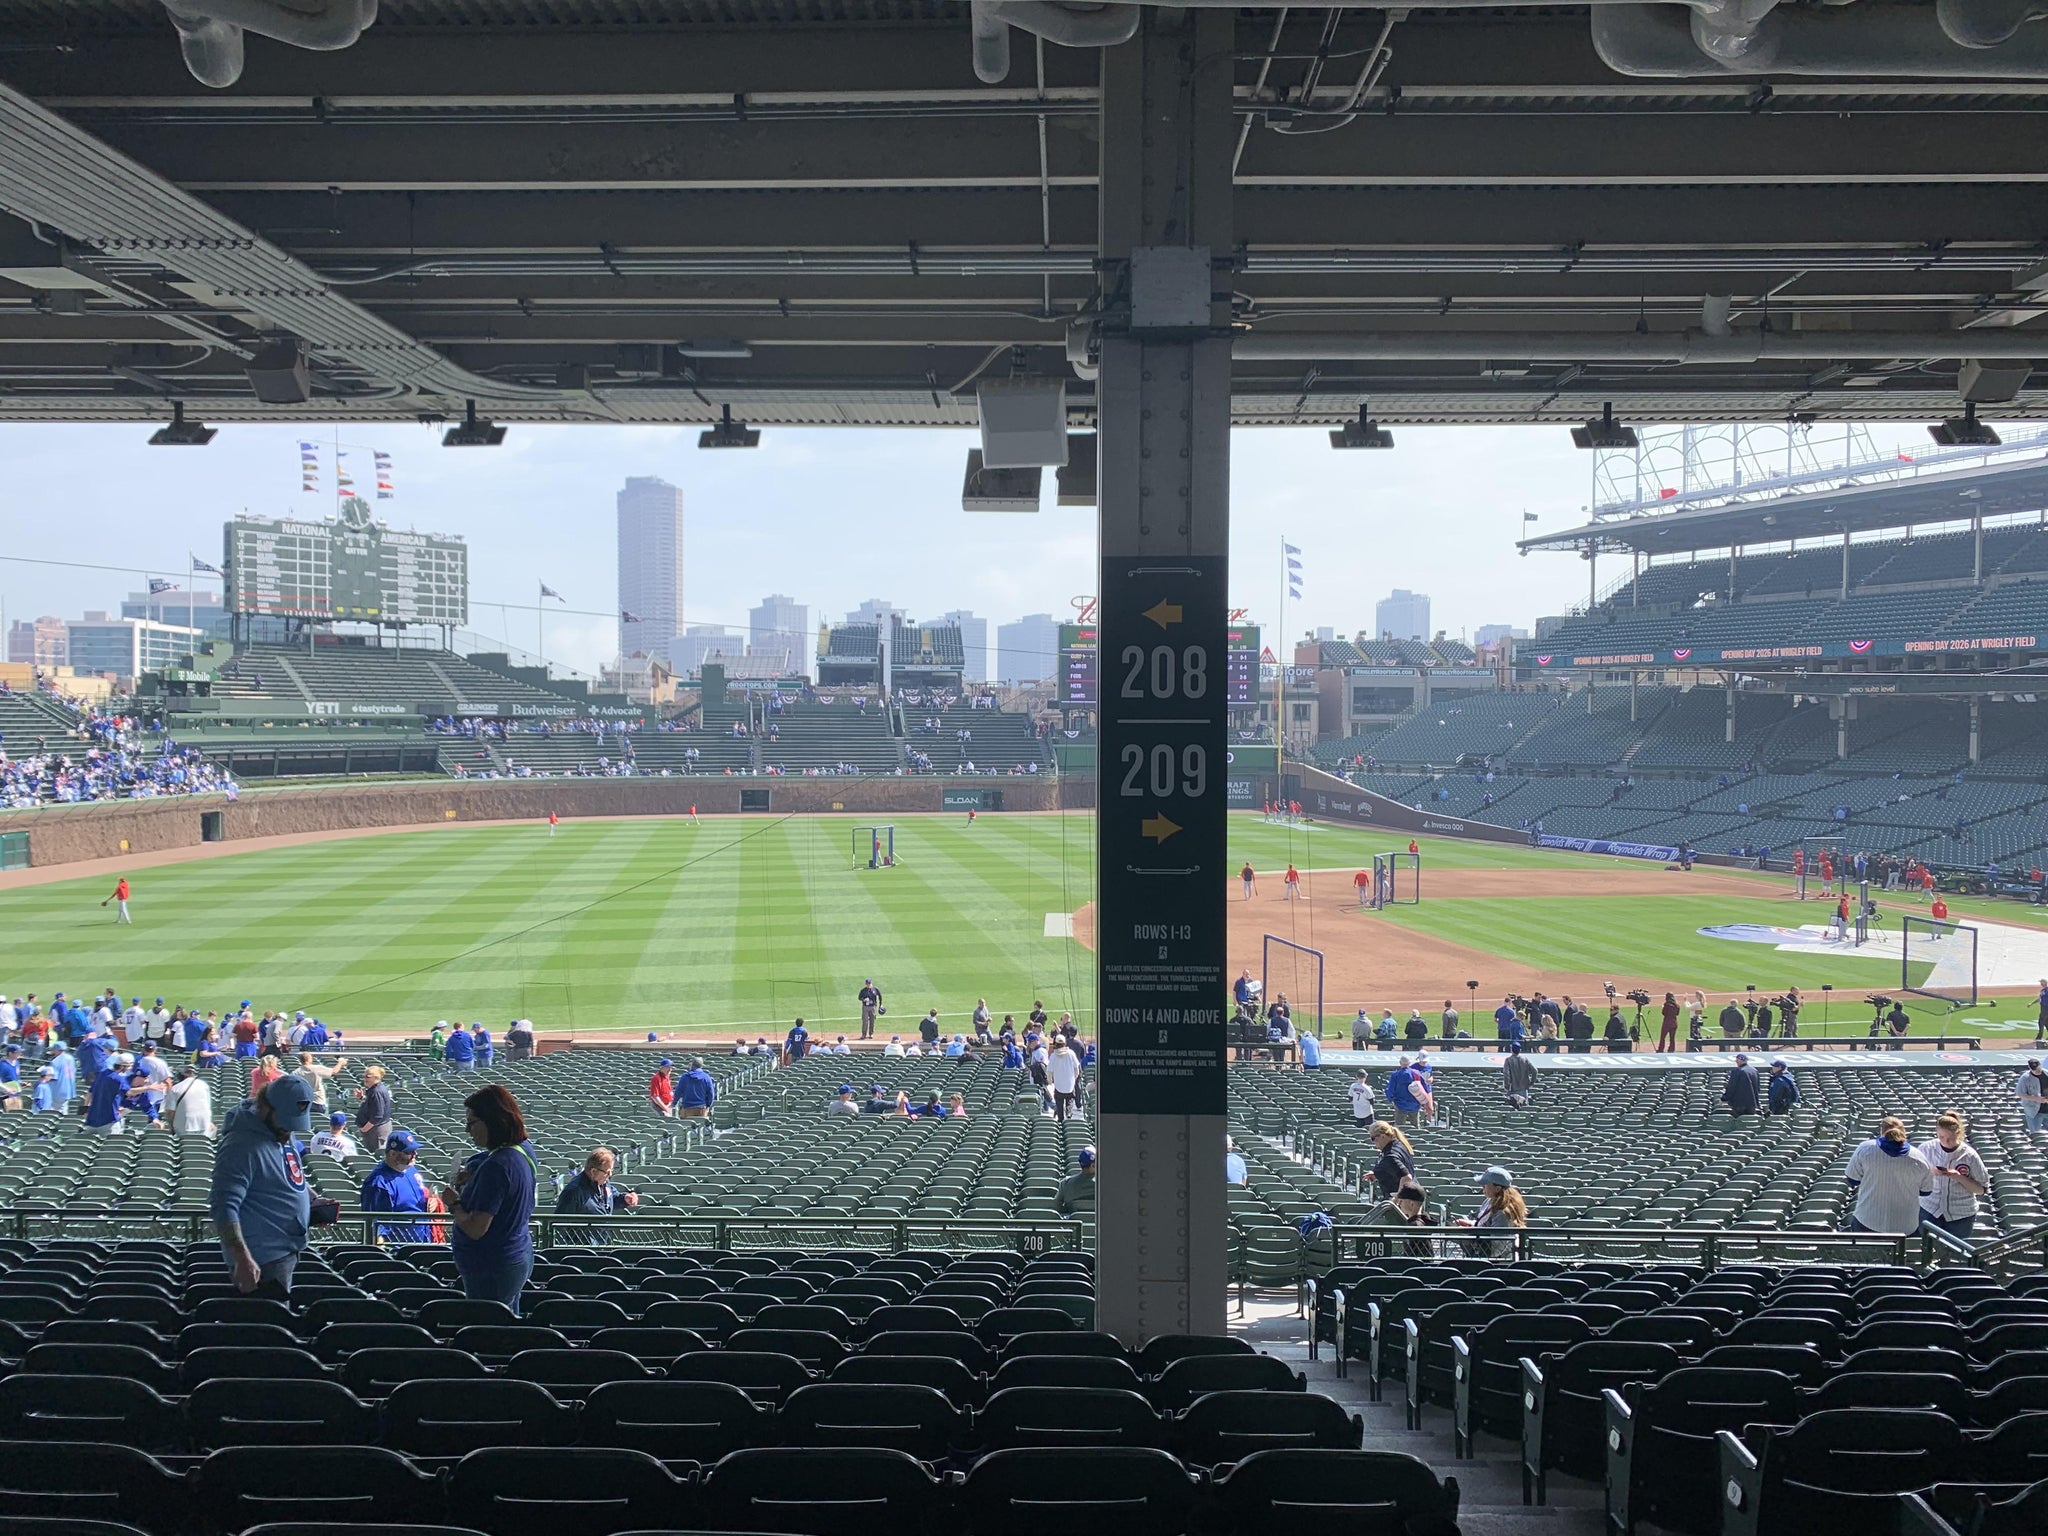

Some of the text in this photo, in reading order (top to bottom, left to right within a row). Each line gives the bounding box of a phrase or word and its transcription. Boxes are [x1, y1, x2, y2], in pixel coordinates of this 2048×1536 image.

[281, 523, 332, 537] NATIONAL
[380, 532, 426, 546] AMERICAN
[1905, 636, 2036, 652] OPENING DAY 2026 AT WRIGLEY FIELD
[1721, 646, 1822, 659] OPENING DAY 2026 AT WRIGLEY FIELD
[186, 671, 211, 682] Mobile
[1121, 645, 1207, 698] 208
[305, 702, 340, 714] YETI
[357, 703, 406, 715] tastytrade
[457, 703, 498, 711] GRAINGER
[512, 704, 575, 716] Budweiser
[601, 706, 642, 716] Advocate
[1120, 744, 1206, 797] 209
[1431, 821, 1452, 830] Invesco
[1565, 839, 1585, 850] Wrap
[1607, 841, 1669, 860] Reynolds Wrap
[1134, 924, 1192, 940] ROWS 1-13
[1106, 1008, 1220, 1024] ROWS 14 AND ABOVE
[1552, 1053, 1907, 1066] CHICAGO CUBS
[1356, 1092, 1361, 1101] 7
[1023, 1236, 1043, 1251] 208
[1364, 1241, 1385, 1257] 209
